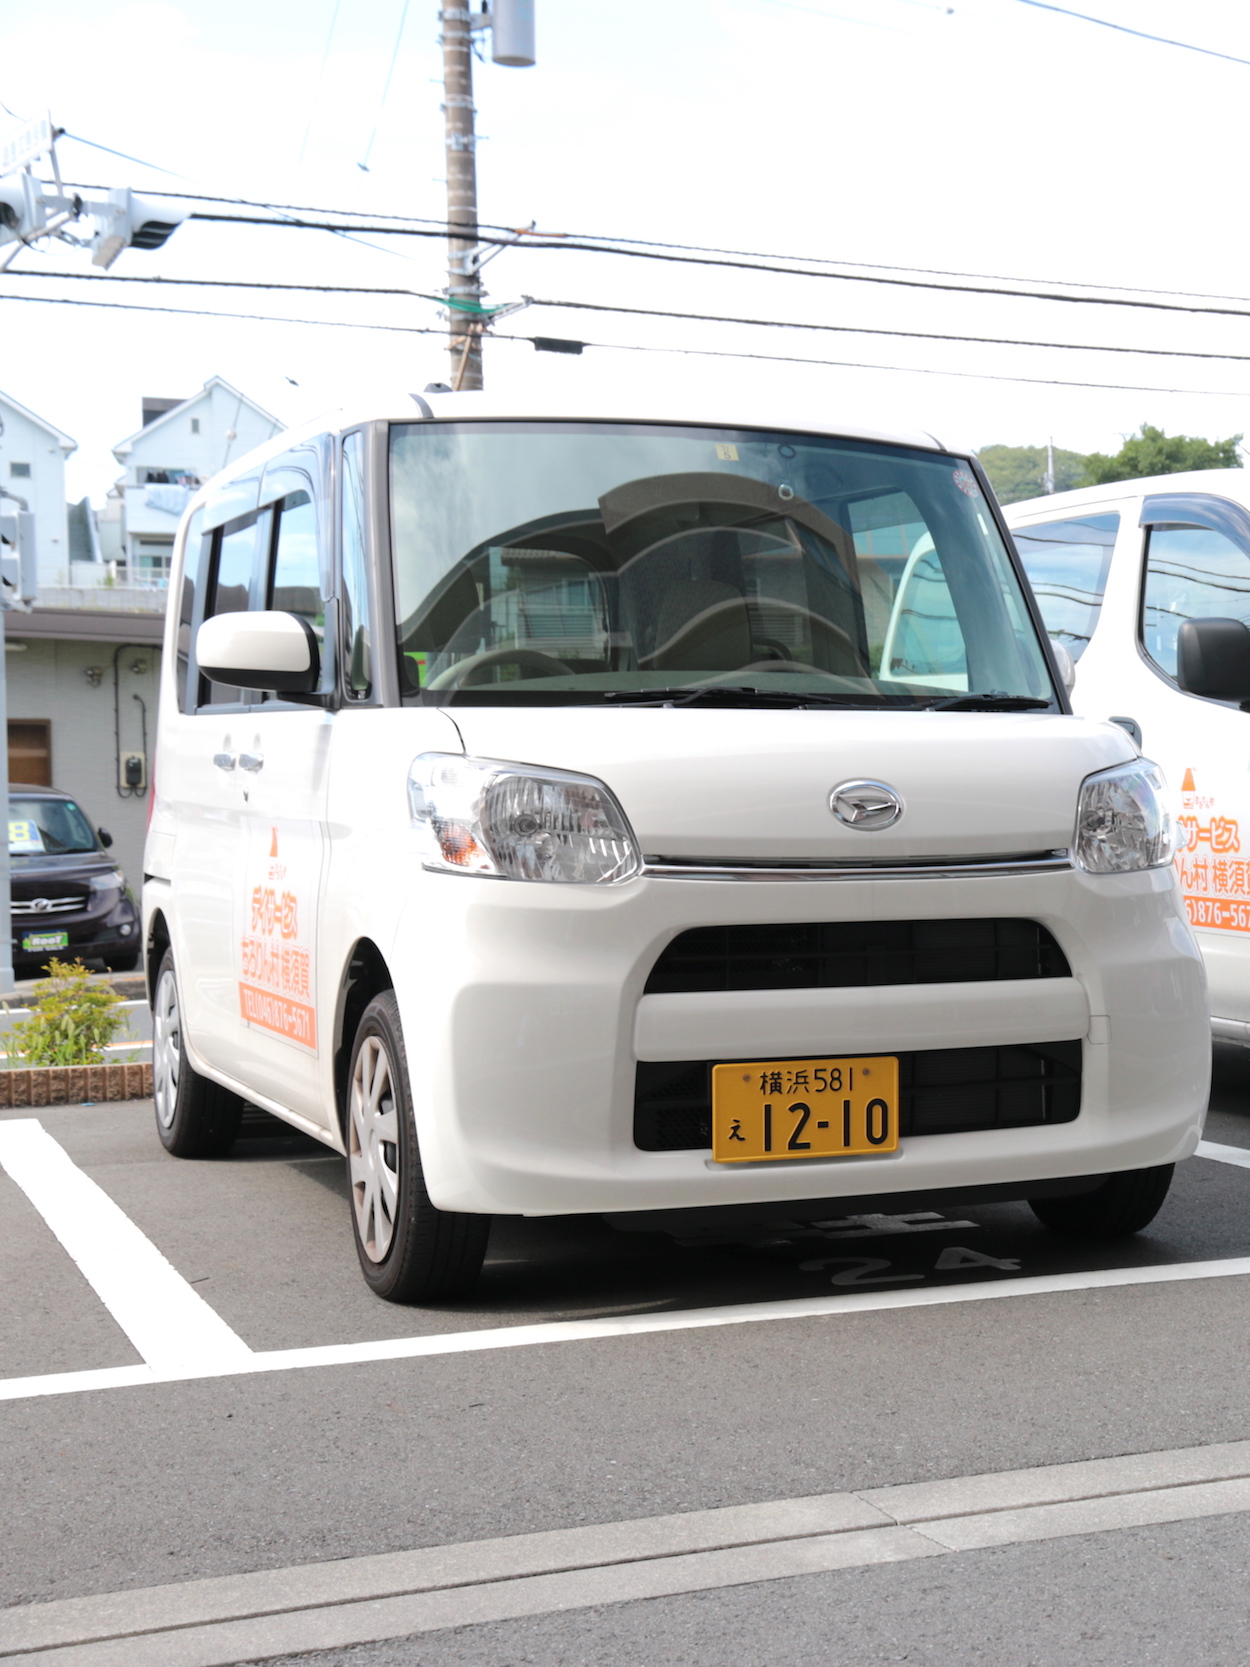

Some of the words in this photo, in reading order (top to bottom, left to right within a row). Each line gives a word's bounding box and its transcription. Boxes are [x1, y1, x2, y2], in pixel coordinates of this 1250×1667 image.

[251, 886, 298, 939] デイサービス
[281, 945, 310, 999] 横須賀
[759, 1067, 853, 1095] 横浜581
[728, 1119, 746, 1141] え
[764, 1097, 889, 1152] 12-10
[798, 1245, 1022, 1286] 24
